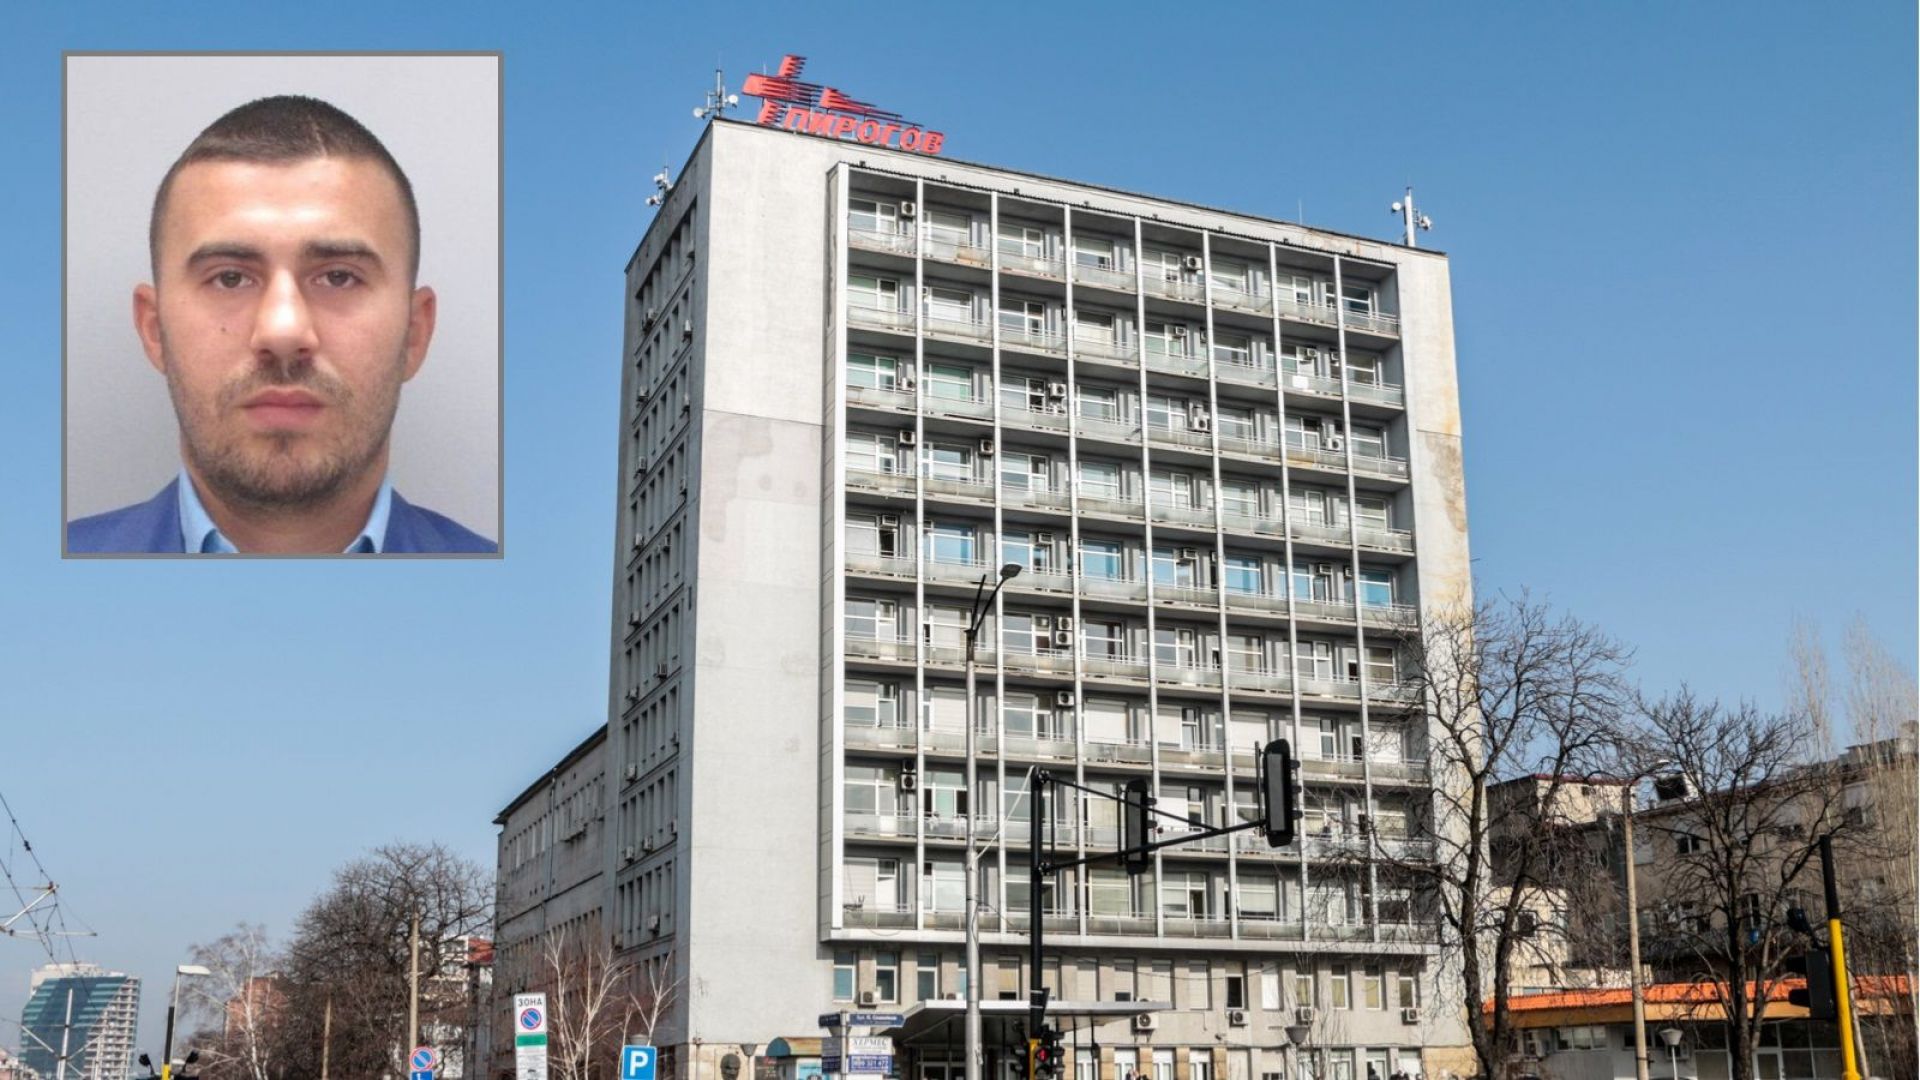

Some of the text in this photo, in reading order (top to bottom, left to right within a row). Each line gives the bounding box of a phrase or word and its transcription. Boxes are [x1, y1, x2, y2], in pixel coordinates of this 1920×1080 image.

[783, 105, 945, 155] ПИРОГОВ
[518, 997, 543, 1007] ЗОНА
[630, 1050, 648, 1077] P
